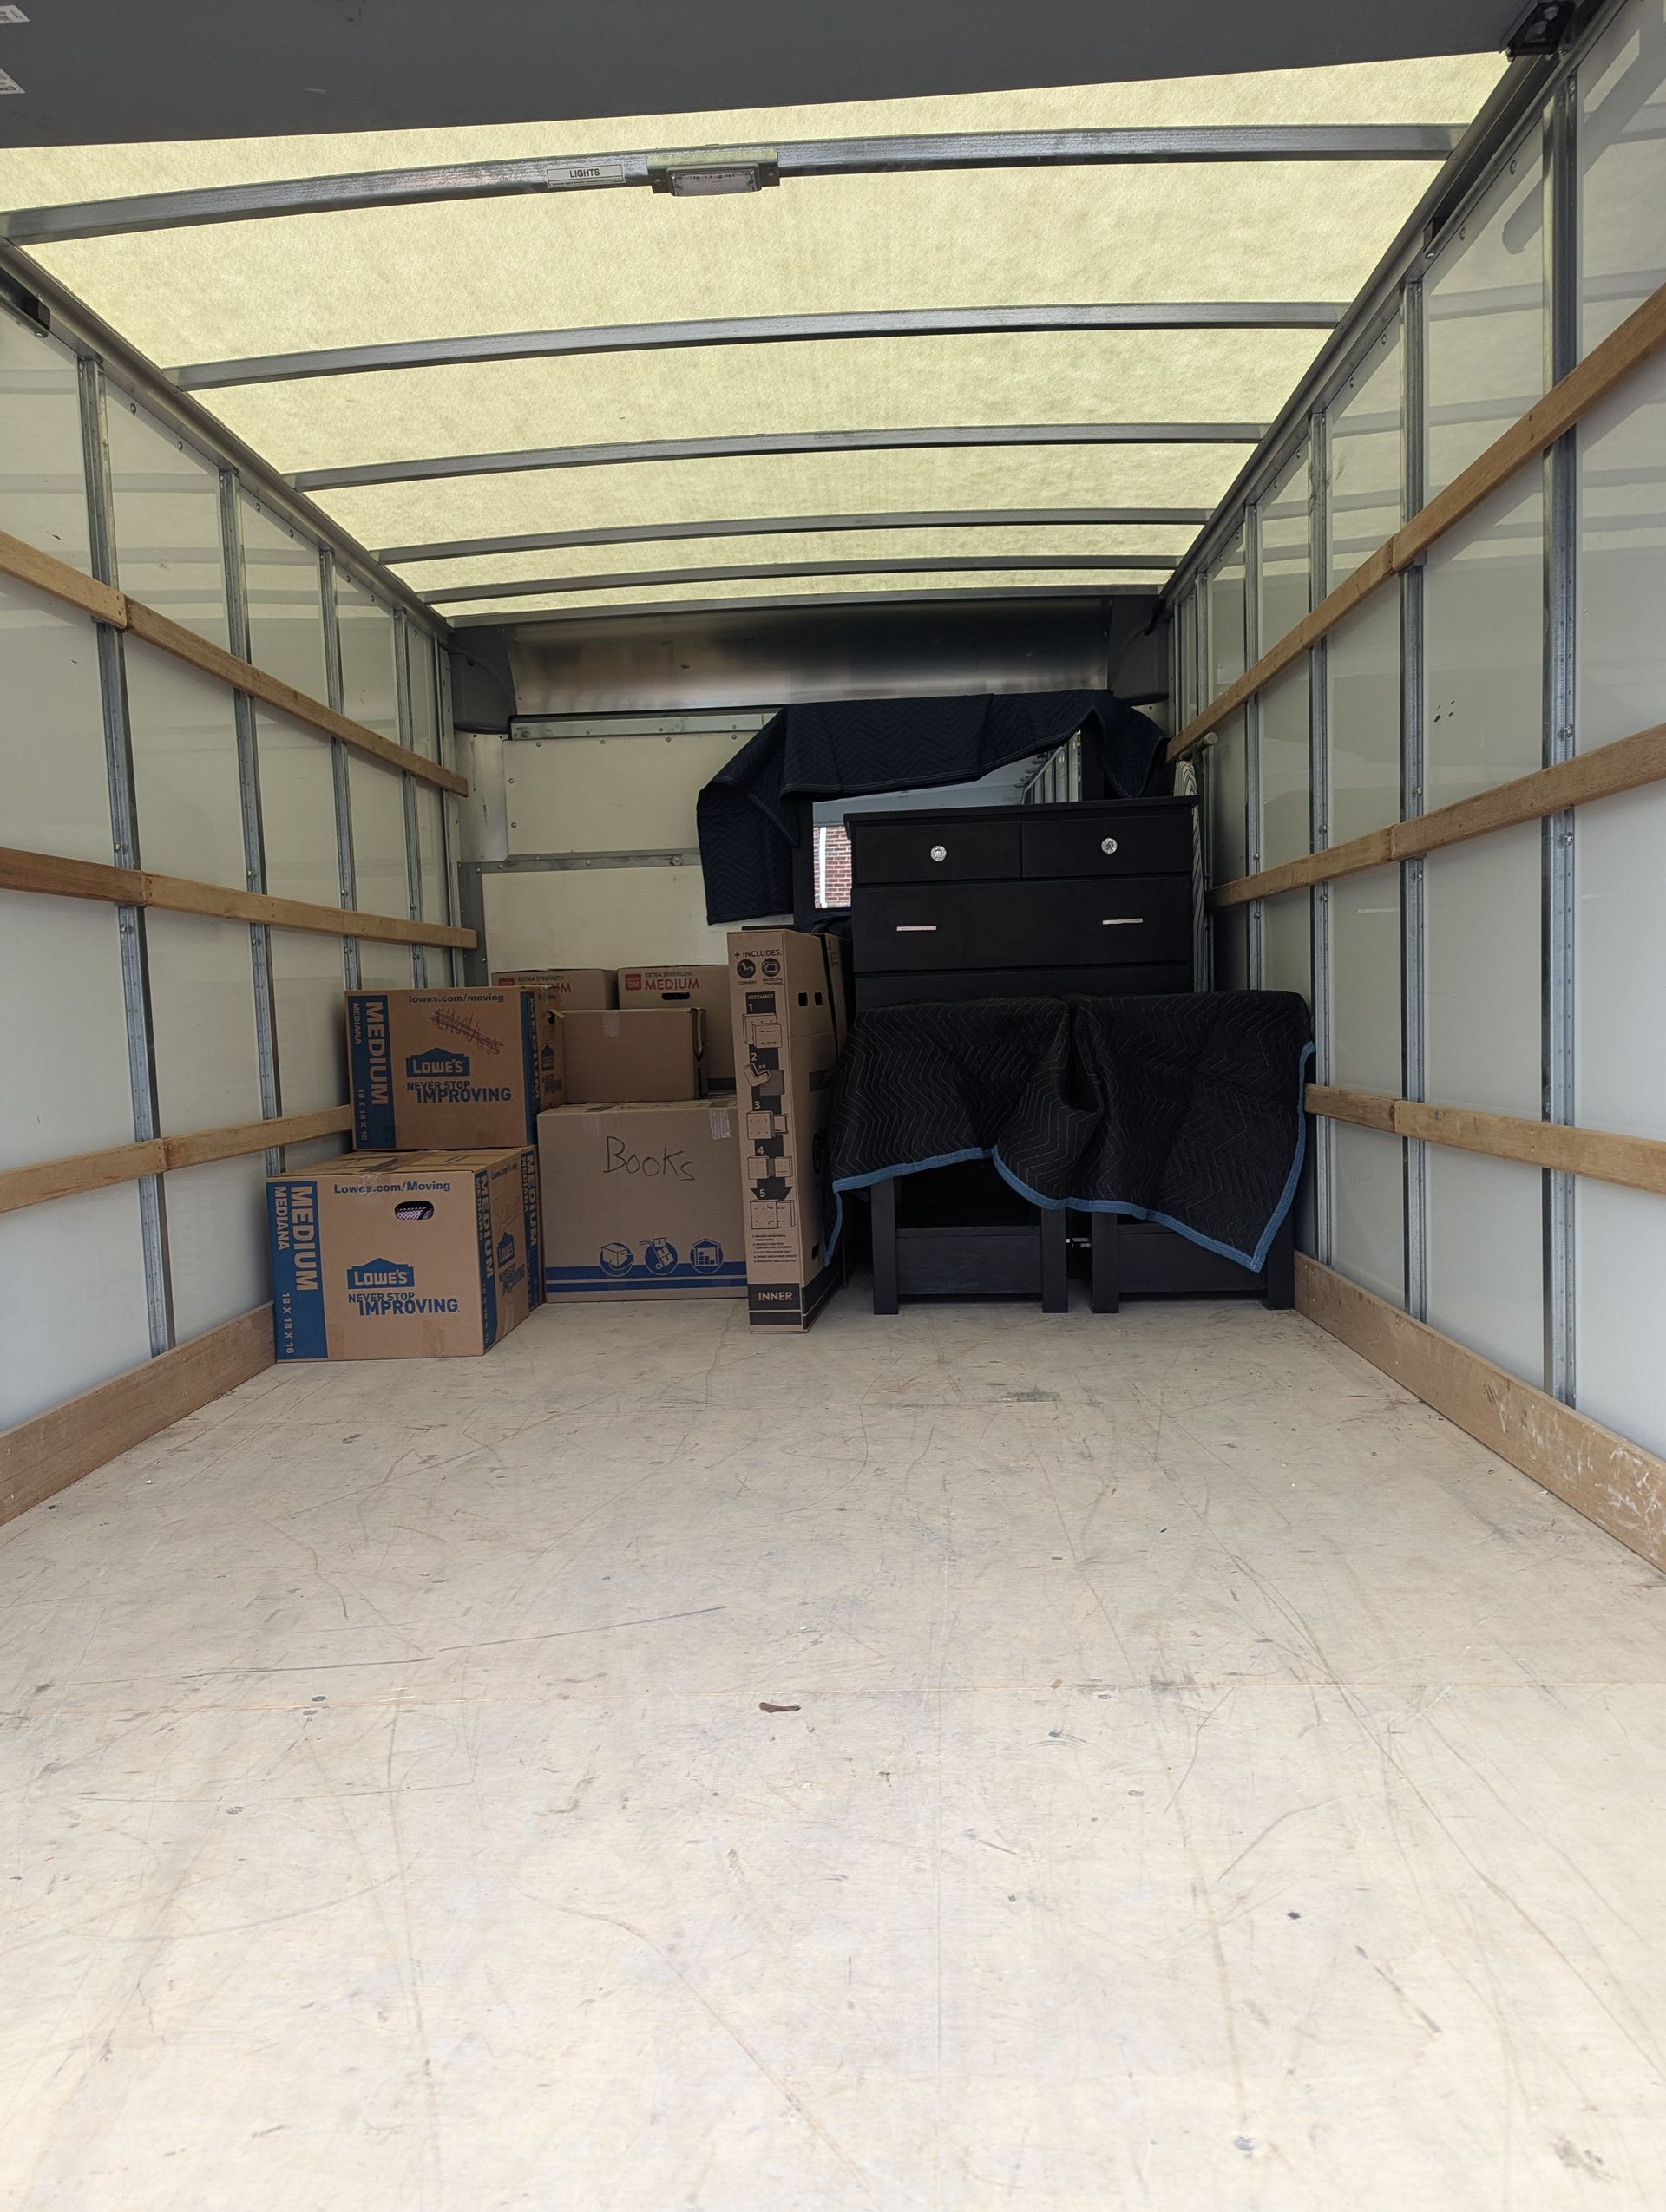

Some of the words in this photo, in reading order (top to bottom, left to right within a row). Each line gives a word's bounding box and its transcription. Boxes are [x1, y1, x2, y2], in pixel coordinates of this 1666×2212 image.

[569, 168, 600, 178] LIGHTS
[743, 949, 783, 958] INCLUDES:
[645, 978, 699, 991] MEDIUM
[409, 992, 504, 1004] lowes.com/moving
[748, 1003, 753, 1012] 1
[352, 1003, 363, 1045] MEDIANA
[365, 1001, 390, 1105] MEDIUM
[751, 1052, 758, 1061] 2
[412, 1058, 464, 1074] LOWE'S
[406, 1081, 442, 1090] NEVER
[443, 1080, 471, 1090] STOP
[416, 1087, 512, 1103] IMPROVING
[754, 1101, 761, 1109] 3
[757, 1146, 764, 1155] 4
[333, 1181, 451, 1194] Lowes.com/Moving
[759, 1188, 766, 1198] 5
[527, 1155, 538, 1247] MEDIUM
[274, 1186, 290, 1250] MEDIANA
[481, 1175, 495, 1279] MEDIUM
[291, 1186, 318, 1291] MEDIUM
[354, 1269, 408, 1286] LOWE'S
[282, 1293, 291, 1304] 18
[348, 1293, 384, 1303] NEVER
[386, 1292, 415, 1302] STOP
[758, 1291, 792, 1301] INNER
[358, 1298, 458, 1316] IMPROVING
[284, 1318, 292, 1330] 18
[285, 1343, 294, 1354] 16
